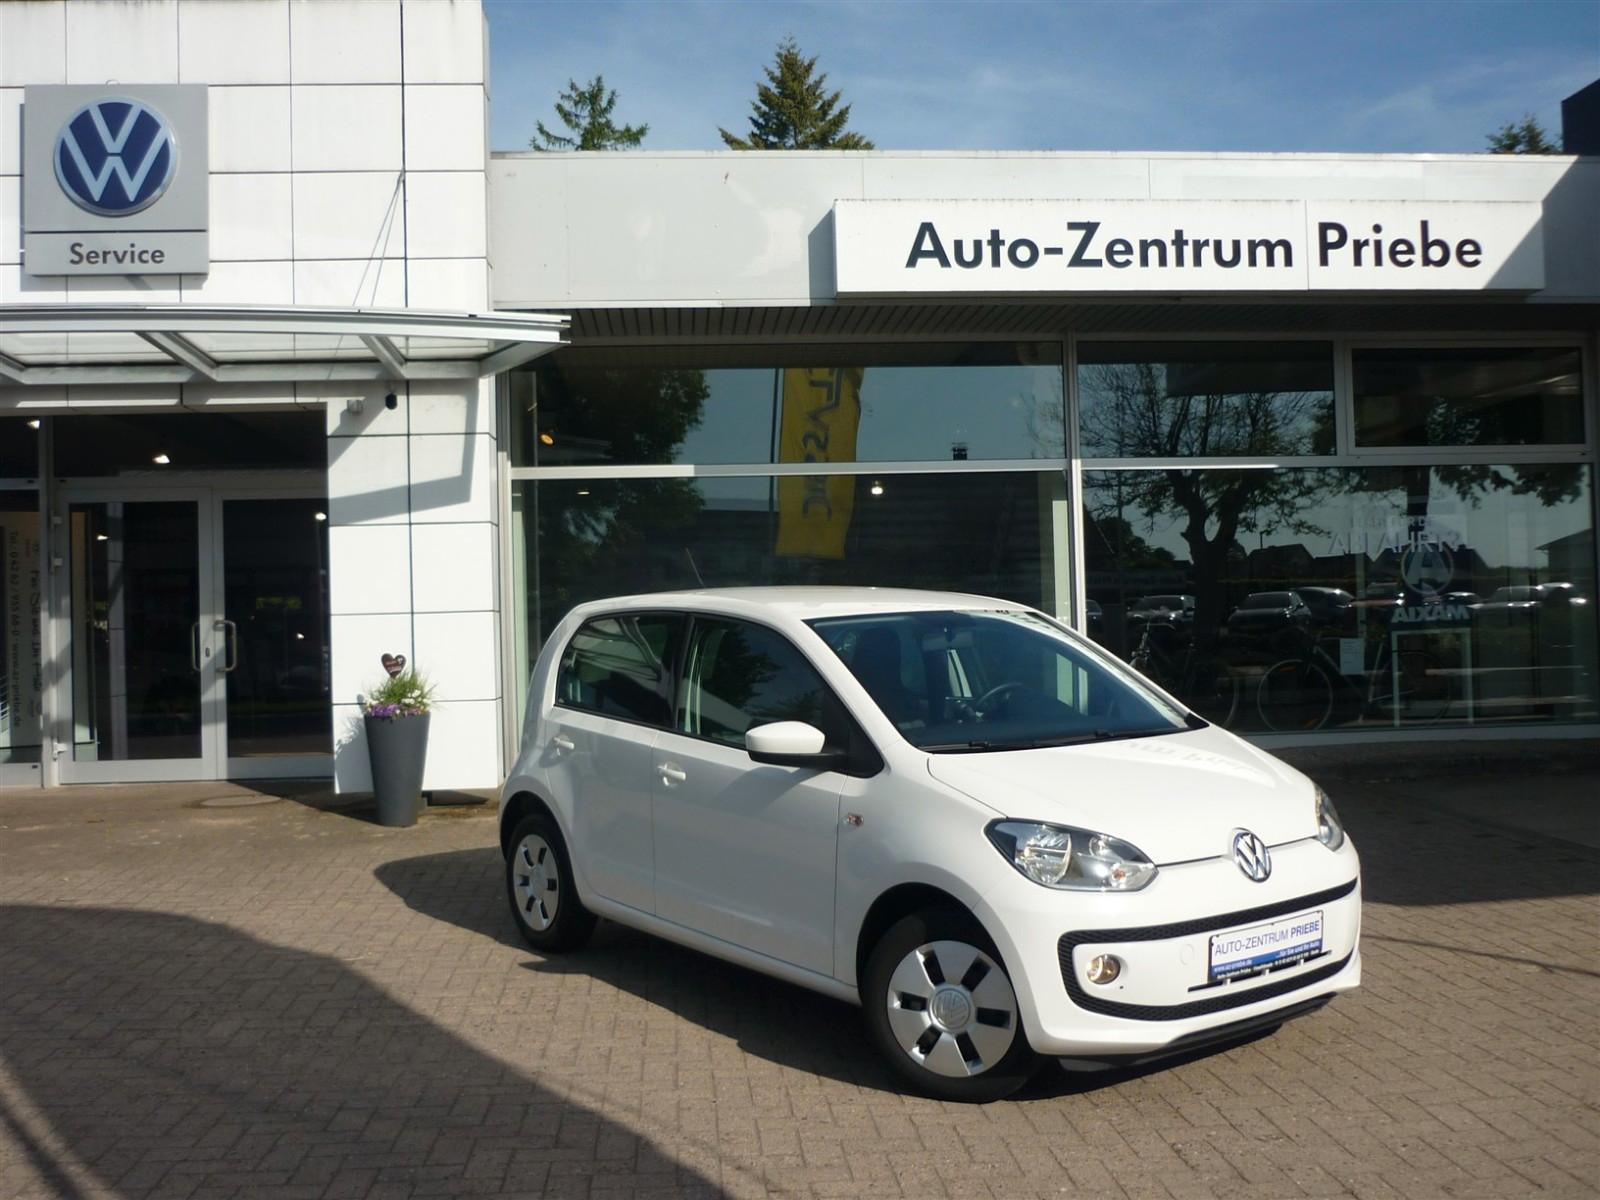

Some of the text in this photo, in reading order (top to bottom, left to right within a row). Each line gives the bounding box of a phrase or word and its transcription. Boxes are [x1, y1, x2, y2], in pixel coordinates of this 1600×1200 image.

[69, 242, 165, 266] Service
[906, 220, 1482, 268] Auto-Zentrum Priebe
[1391, 605, 1471, 623] AIXAM
[1215, 920, 1320, 956] AUTO-ZENTRUM PRIEBE
